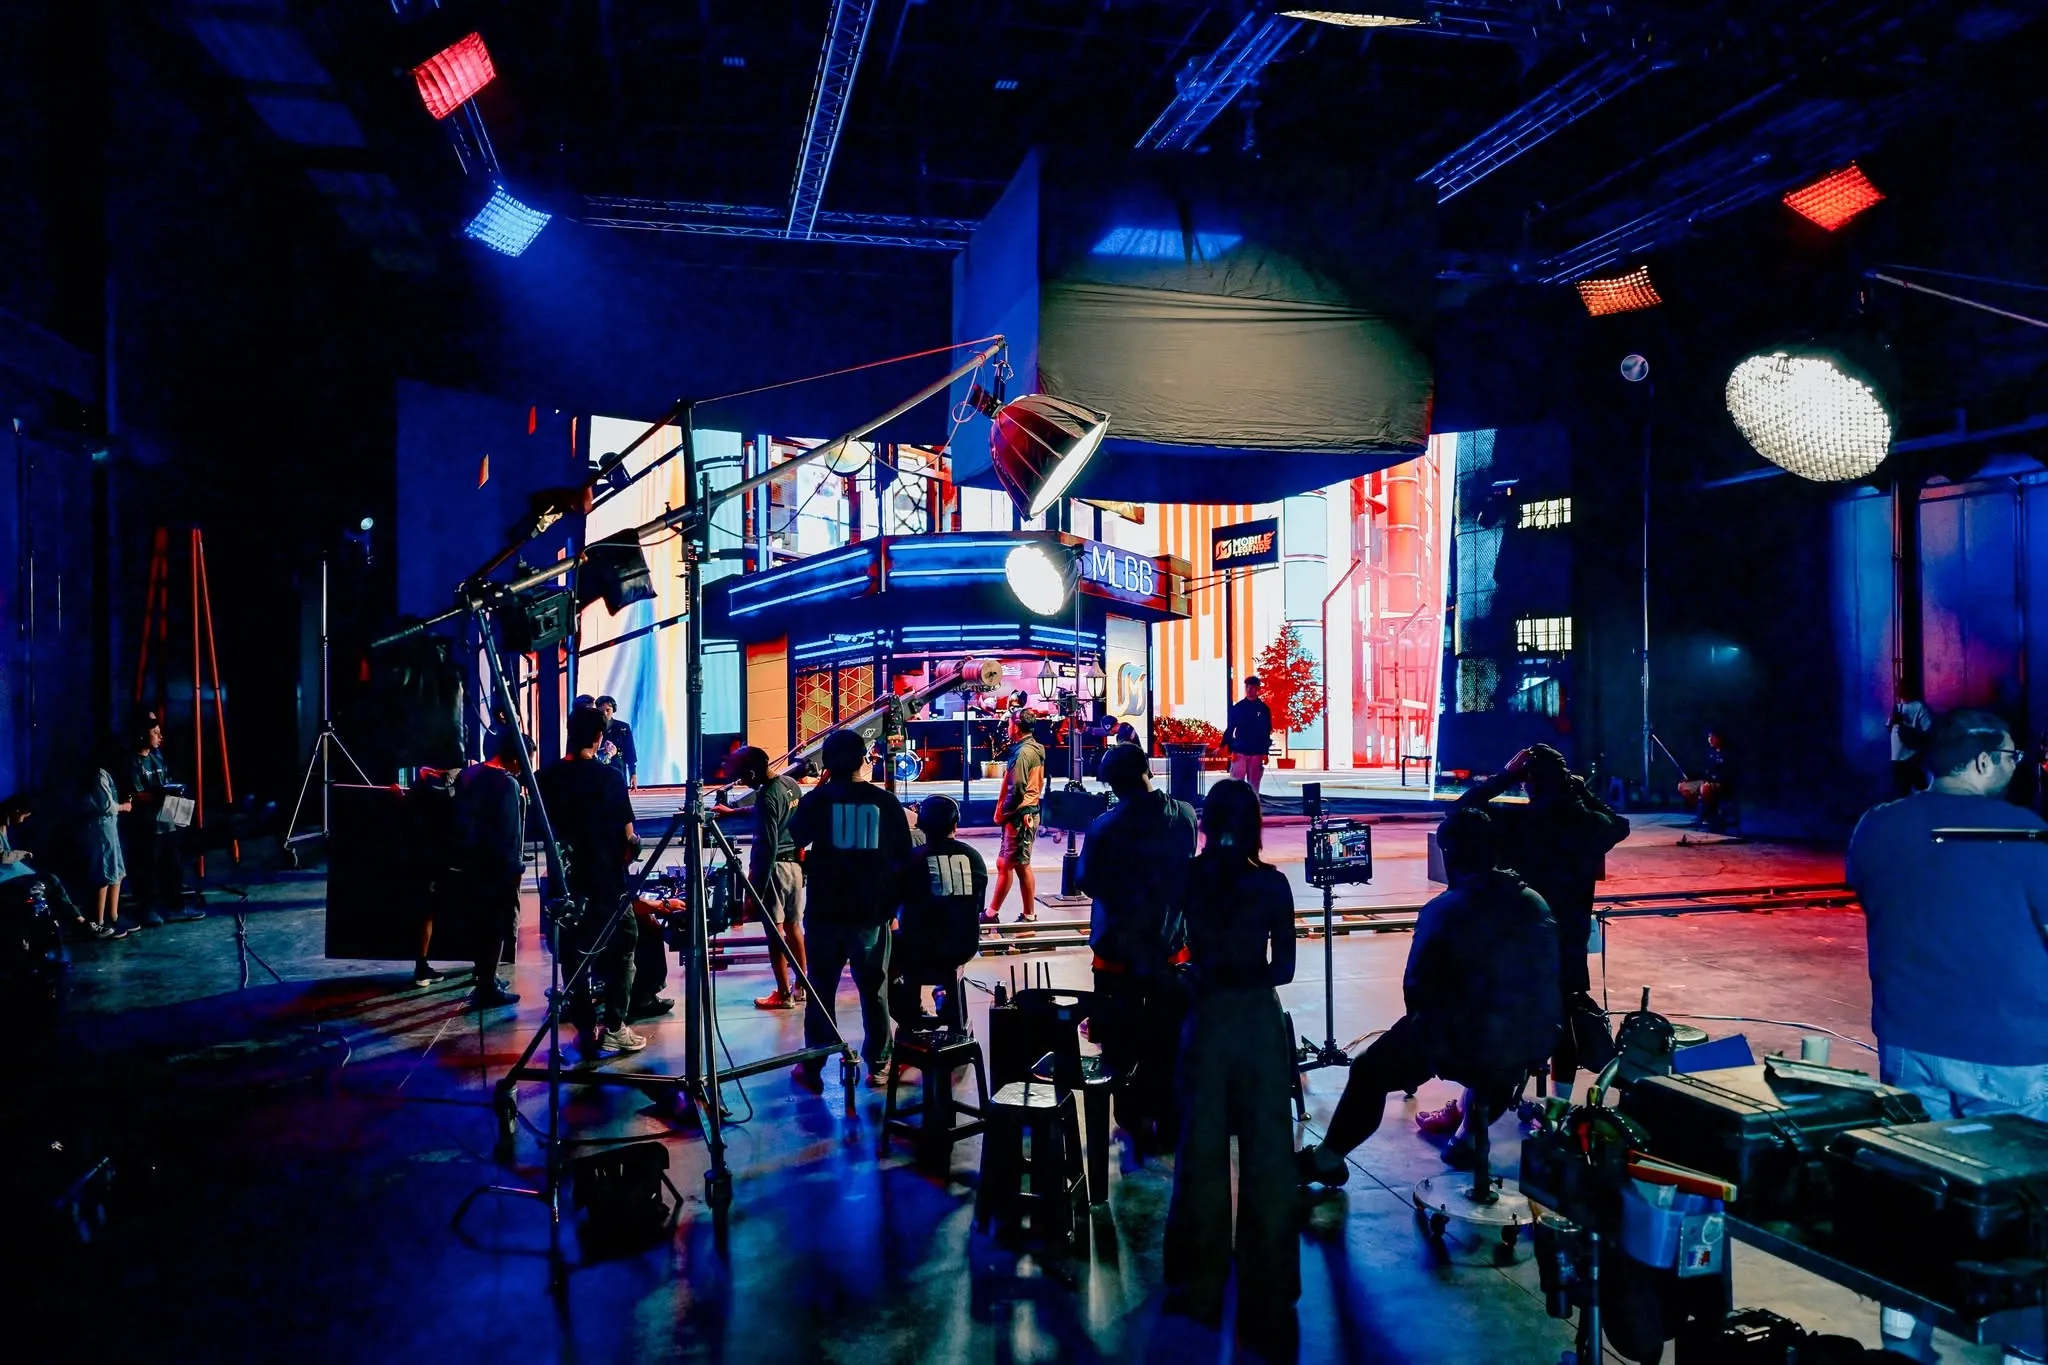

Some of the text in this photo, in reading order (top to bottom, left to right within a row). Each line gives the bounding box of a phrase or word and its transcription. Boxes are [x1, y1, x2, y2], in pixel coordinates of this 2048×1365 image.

[1232, 531, 1275, 547] MOBILE
[1232, 542, 1271, 555] LEGENDS
[1092, 545, 1153, 596] MLBB
